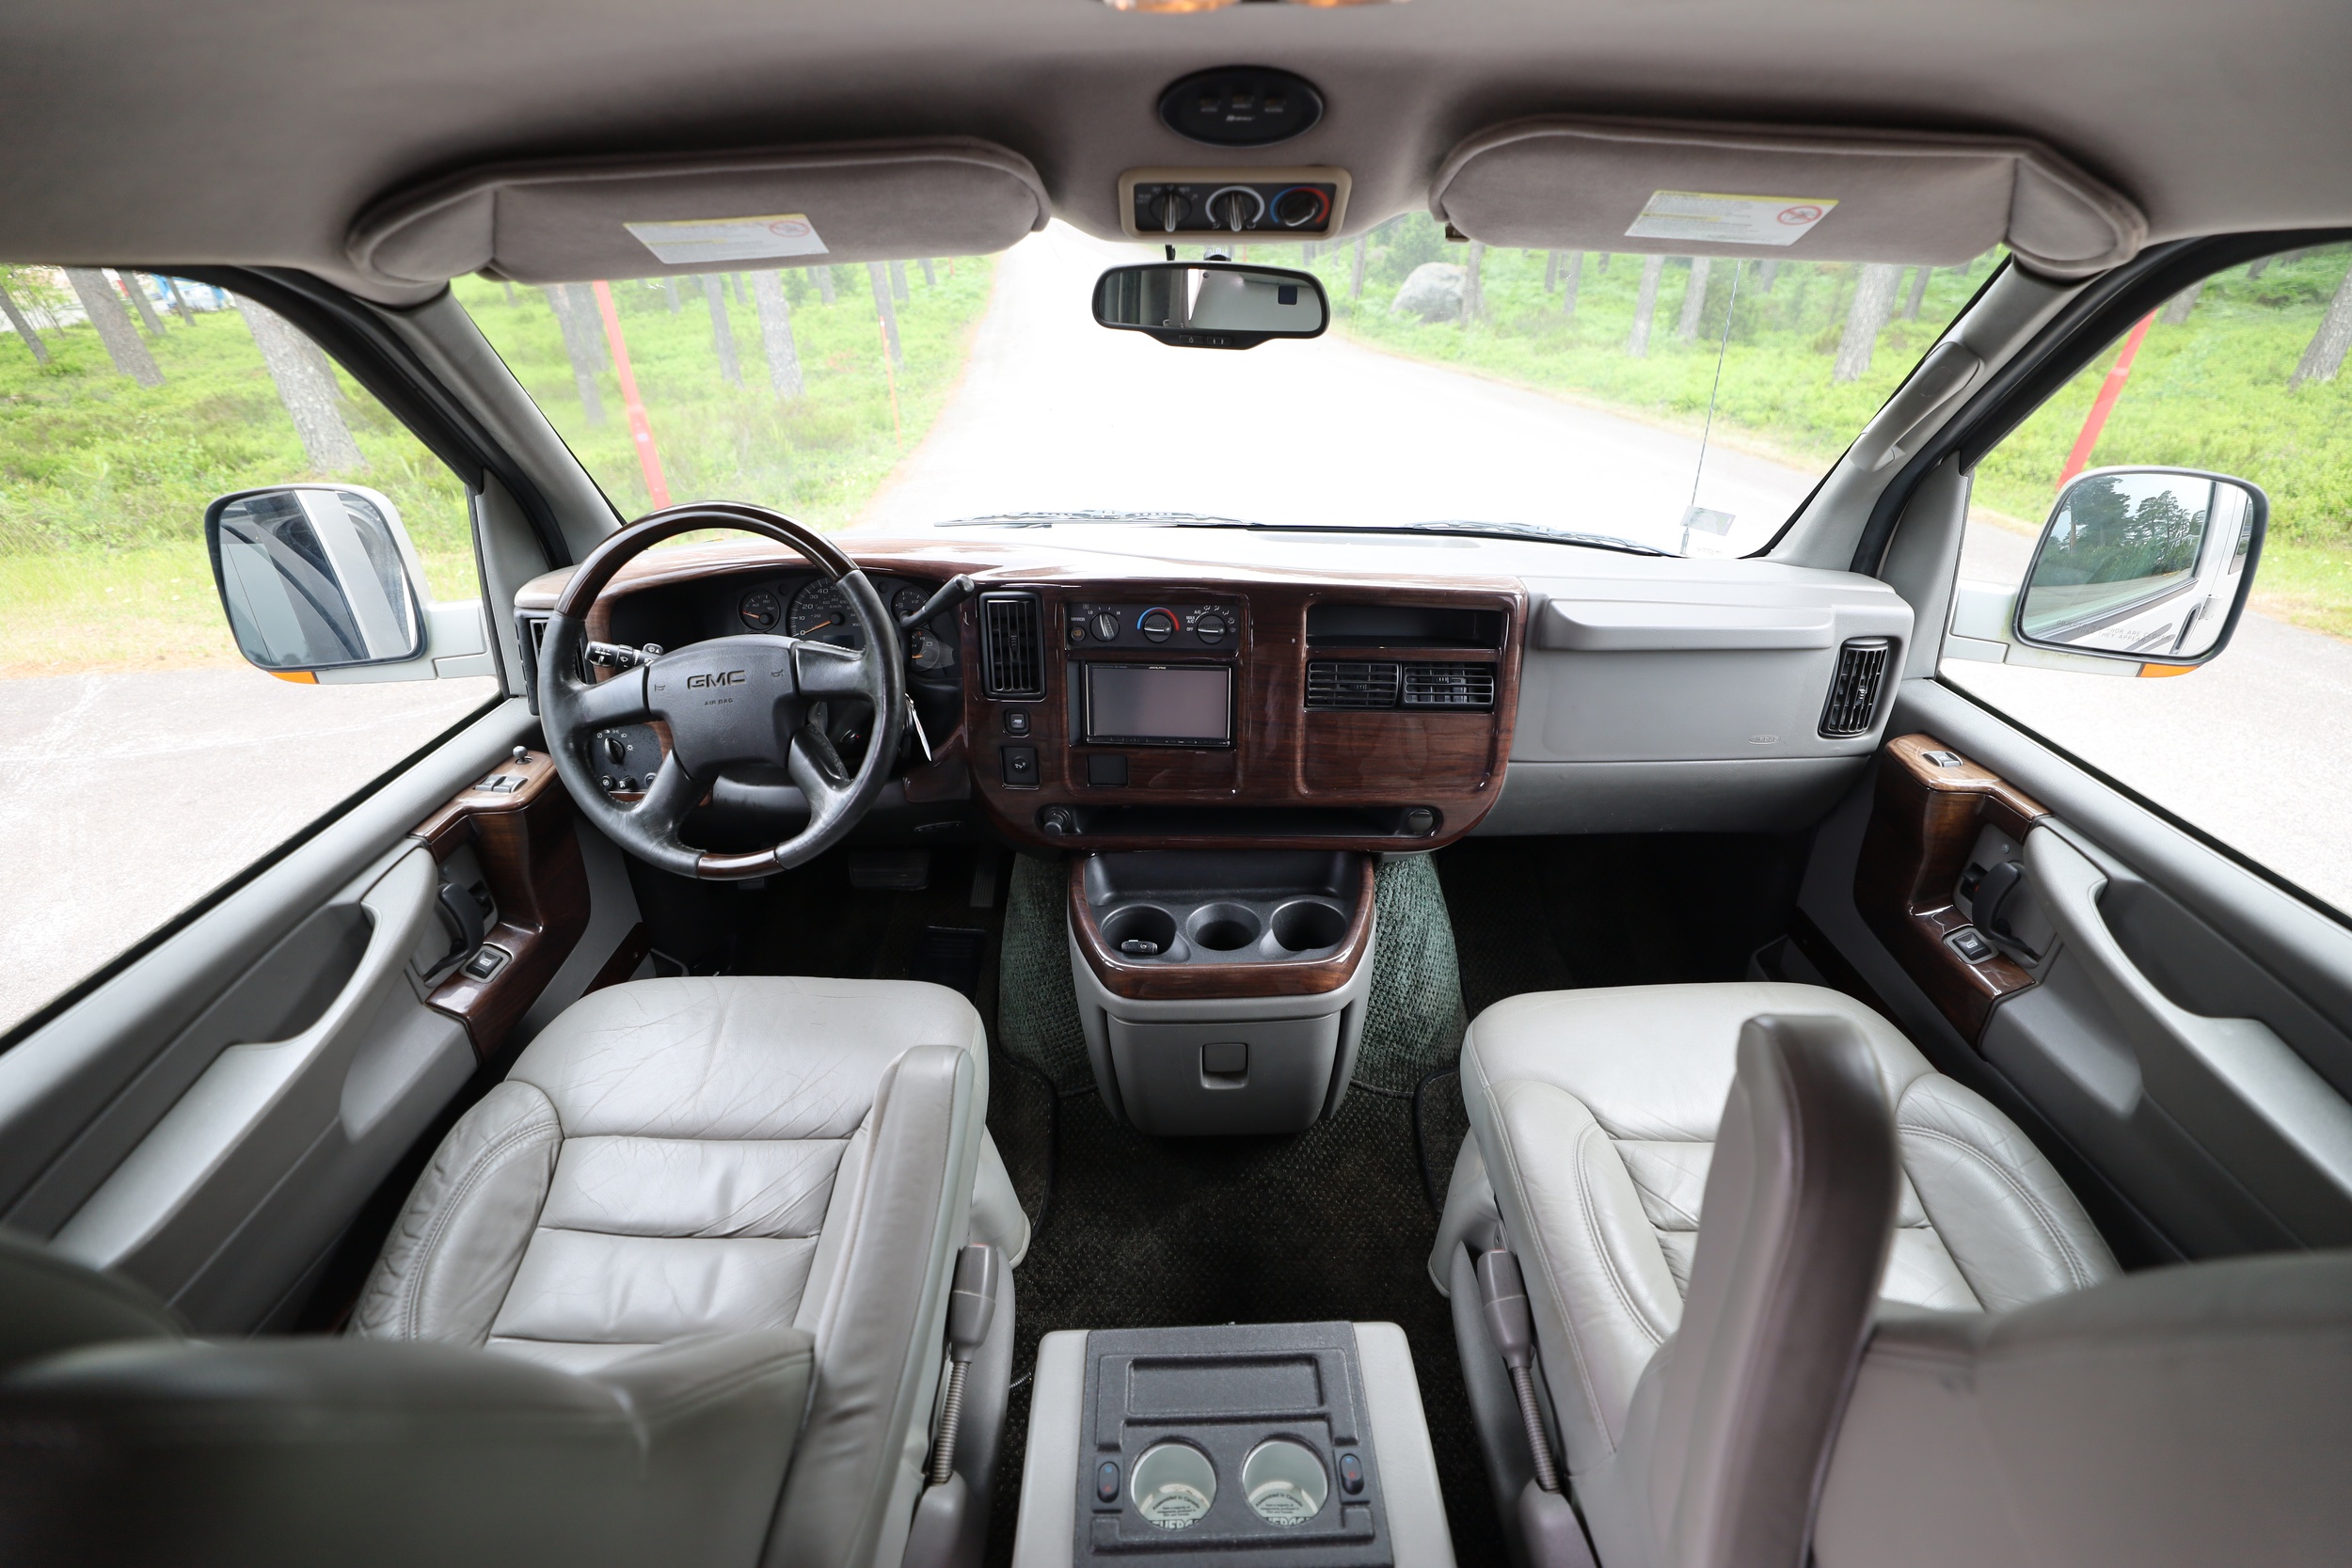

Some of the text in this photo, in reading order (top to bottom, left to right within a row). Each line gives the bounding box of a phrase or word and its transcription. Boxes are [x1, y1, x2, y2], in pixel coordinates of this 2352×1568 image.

[2058, 620, 2086, 628] OBJECT
[687, 670, 746, 690] GMC
[718, 697, 734, 705] BAG
